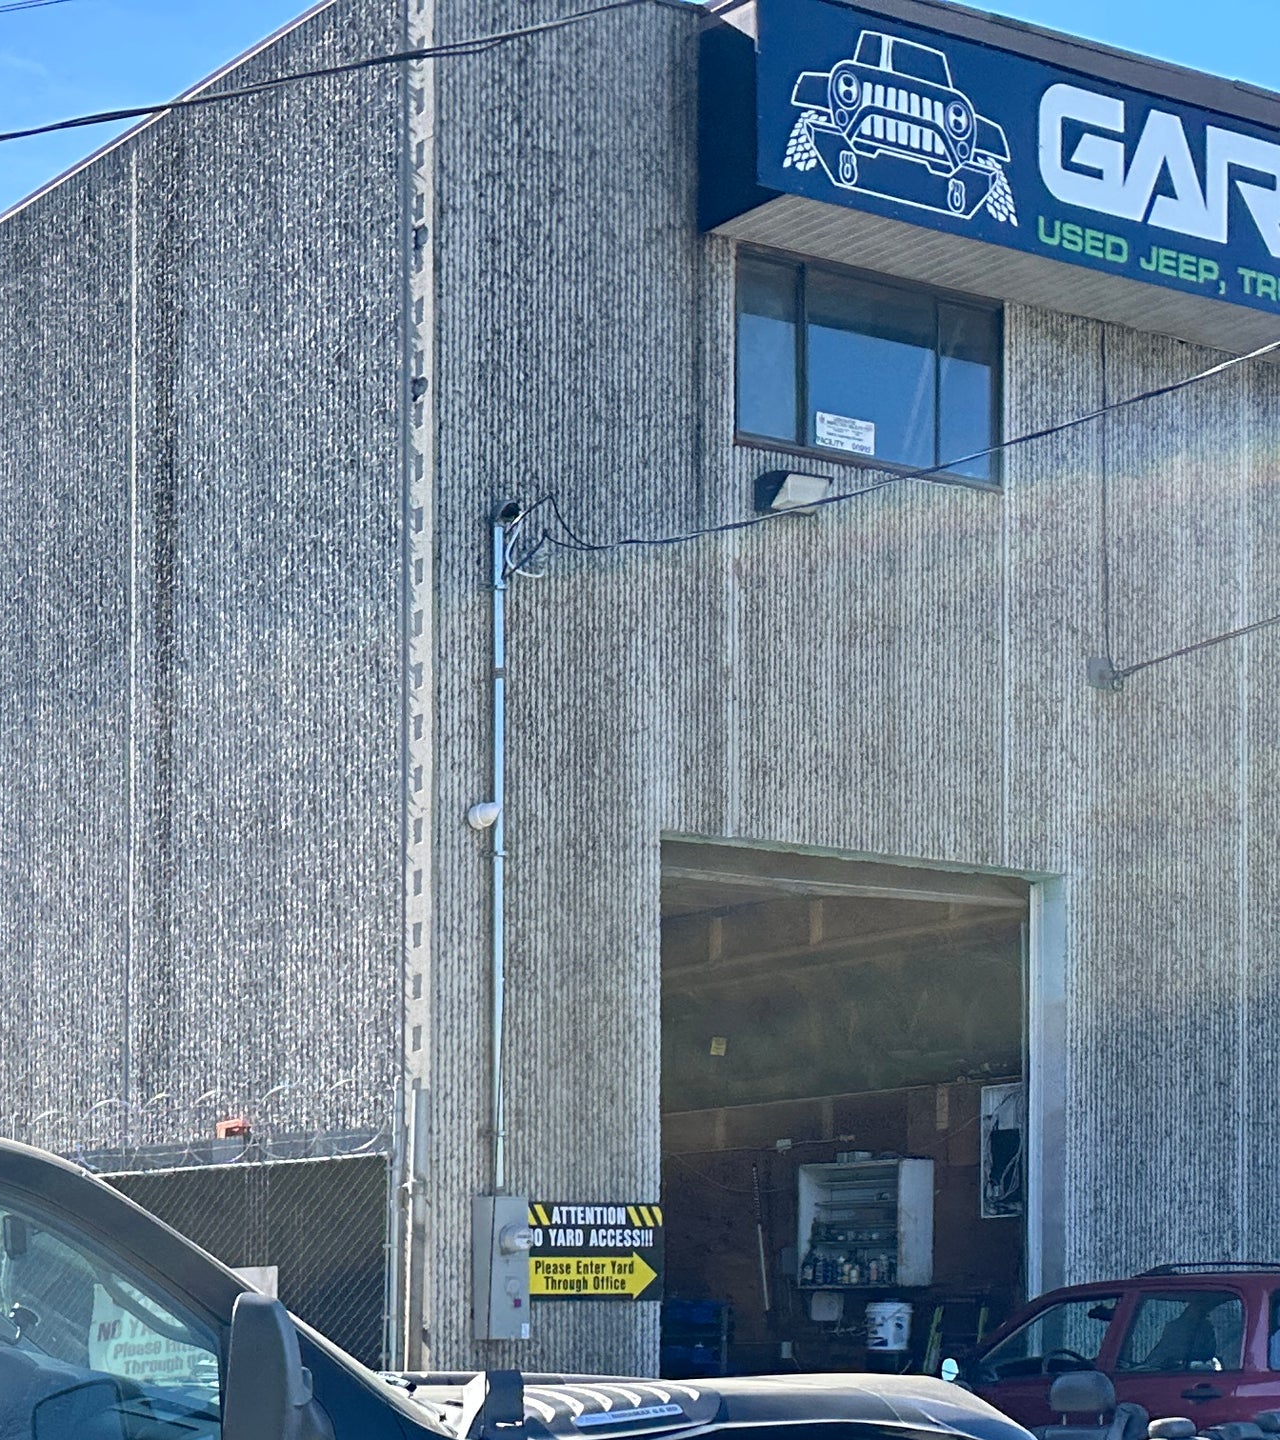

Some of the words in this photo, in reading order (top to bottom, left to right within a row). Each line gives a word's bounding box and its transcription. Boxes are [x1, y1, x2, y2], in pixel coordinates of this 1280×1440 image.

[1037, 215, 1128, 264] USED
[1140, 246, 1226, 295] JEEP,
[1237, 266, 1280, 302] TR
[551, 1206, 626, 1226] ATTENTION
[530, 1229, 543, 1247] O
[549, 1229, 584, 1247] YARD
[589, 1229, 653, 1248] ACCESS!!!
[535, 1260, 571, 1275] Please
[576, 1260, 606, 1275] Enter
[611, 1260, 634, 1275] Yard
[544, 1276, 588, 1292] Through
[593, 1277, 626, 1290] Office
